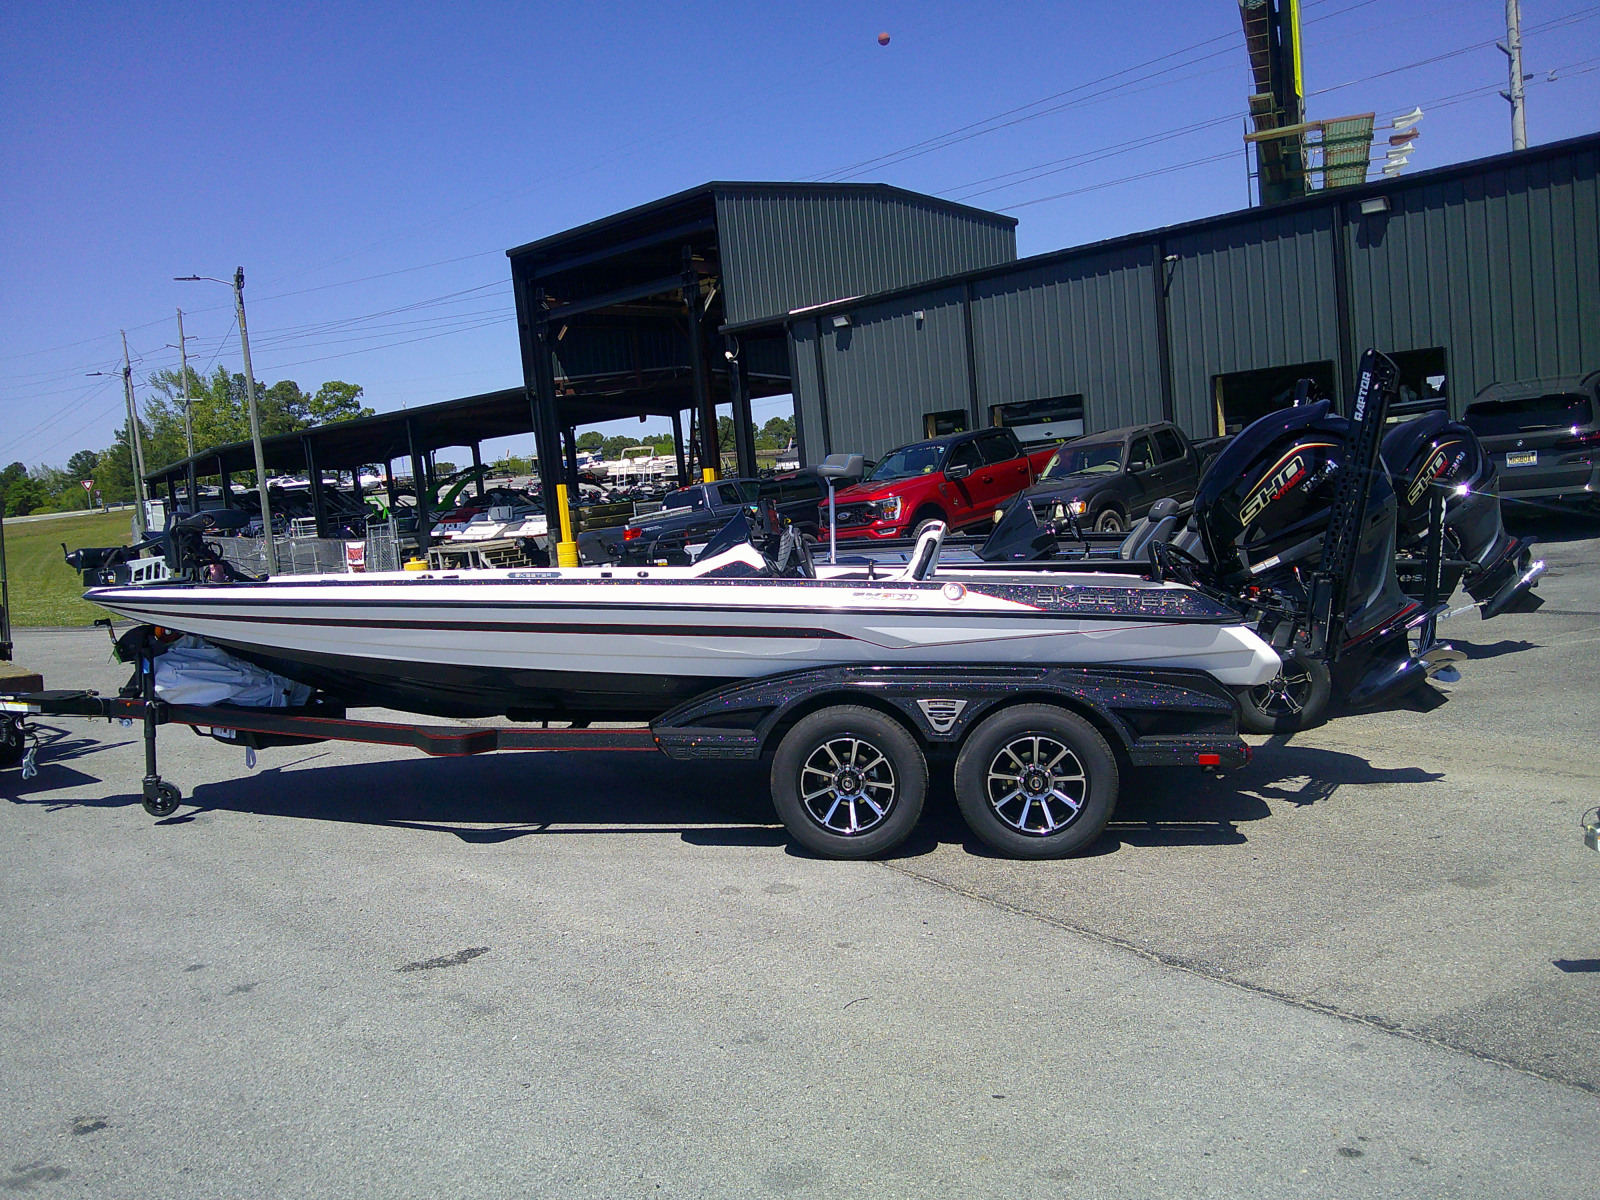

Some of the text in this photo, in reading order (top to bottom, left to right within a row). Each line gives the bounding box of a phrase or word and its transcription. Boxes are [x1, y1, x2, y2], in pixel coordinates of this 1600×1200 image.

[1353, 371, 1372, 421] RAPTOR
[1240, 455, 1305, 526] SHO
[1408, 451, 1447, 506] SHO
[1036, 592, 1180, 607] SKEETER
[676, 746, 756, 757] SKEETER
